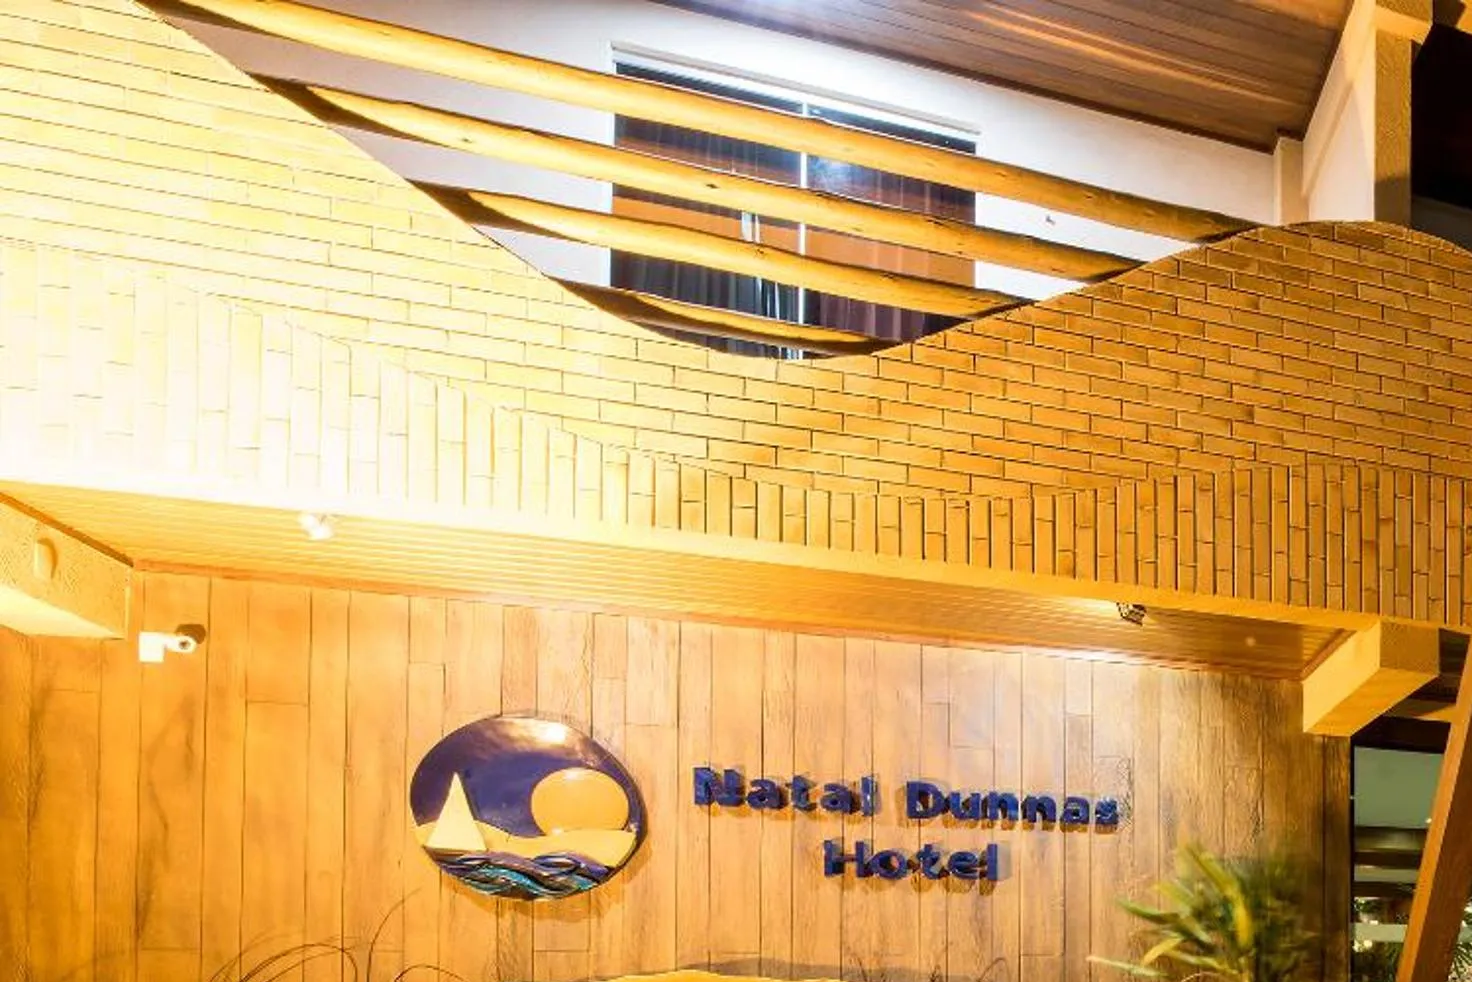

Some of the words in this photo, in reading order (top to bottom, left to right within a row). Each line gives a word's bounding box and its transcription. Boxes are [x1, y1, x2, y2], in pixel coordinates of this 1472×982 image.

[693, 767, 878, 817] Natal
[906, 780, 1120, 826] Dunnas
[823, 839, 1001, 881] Hotel
